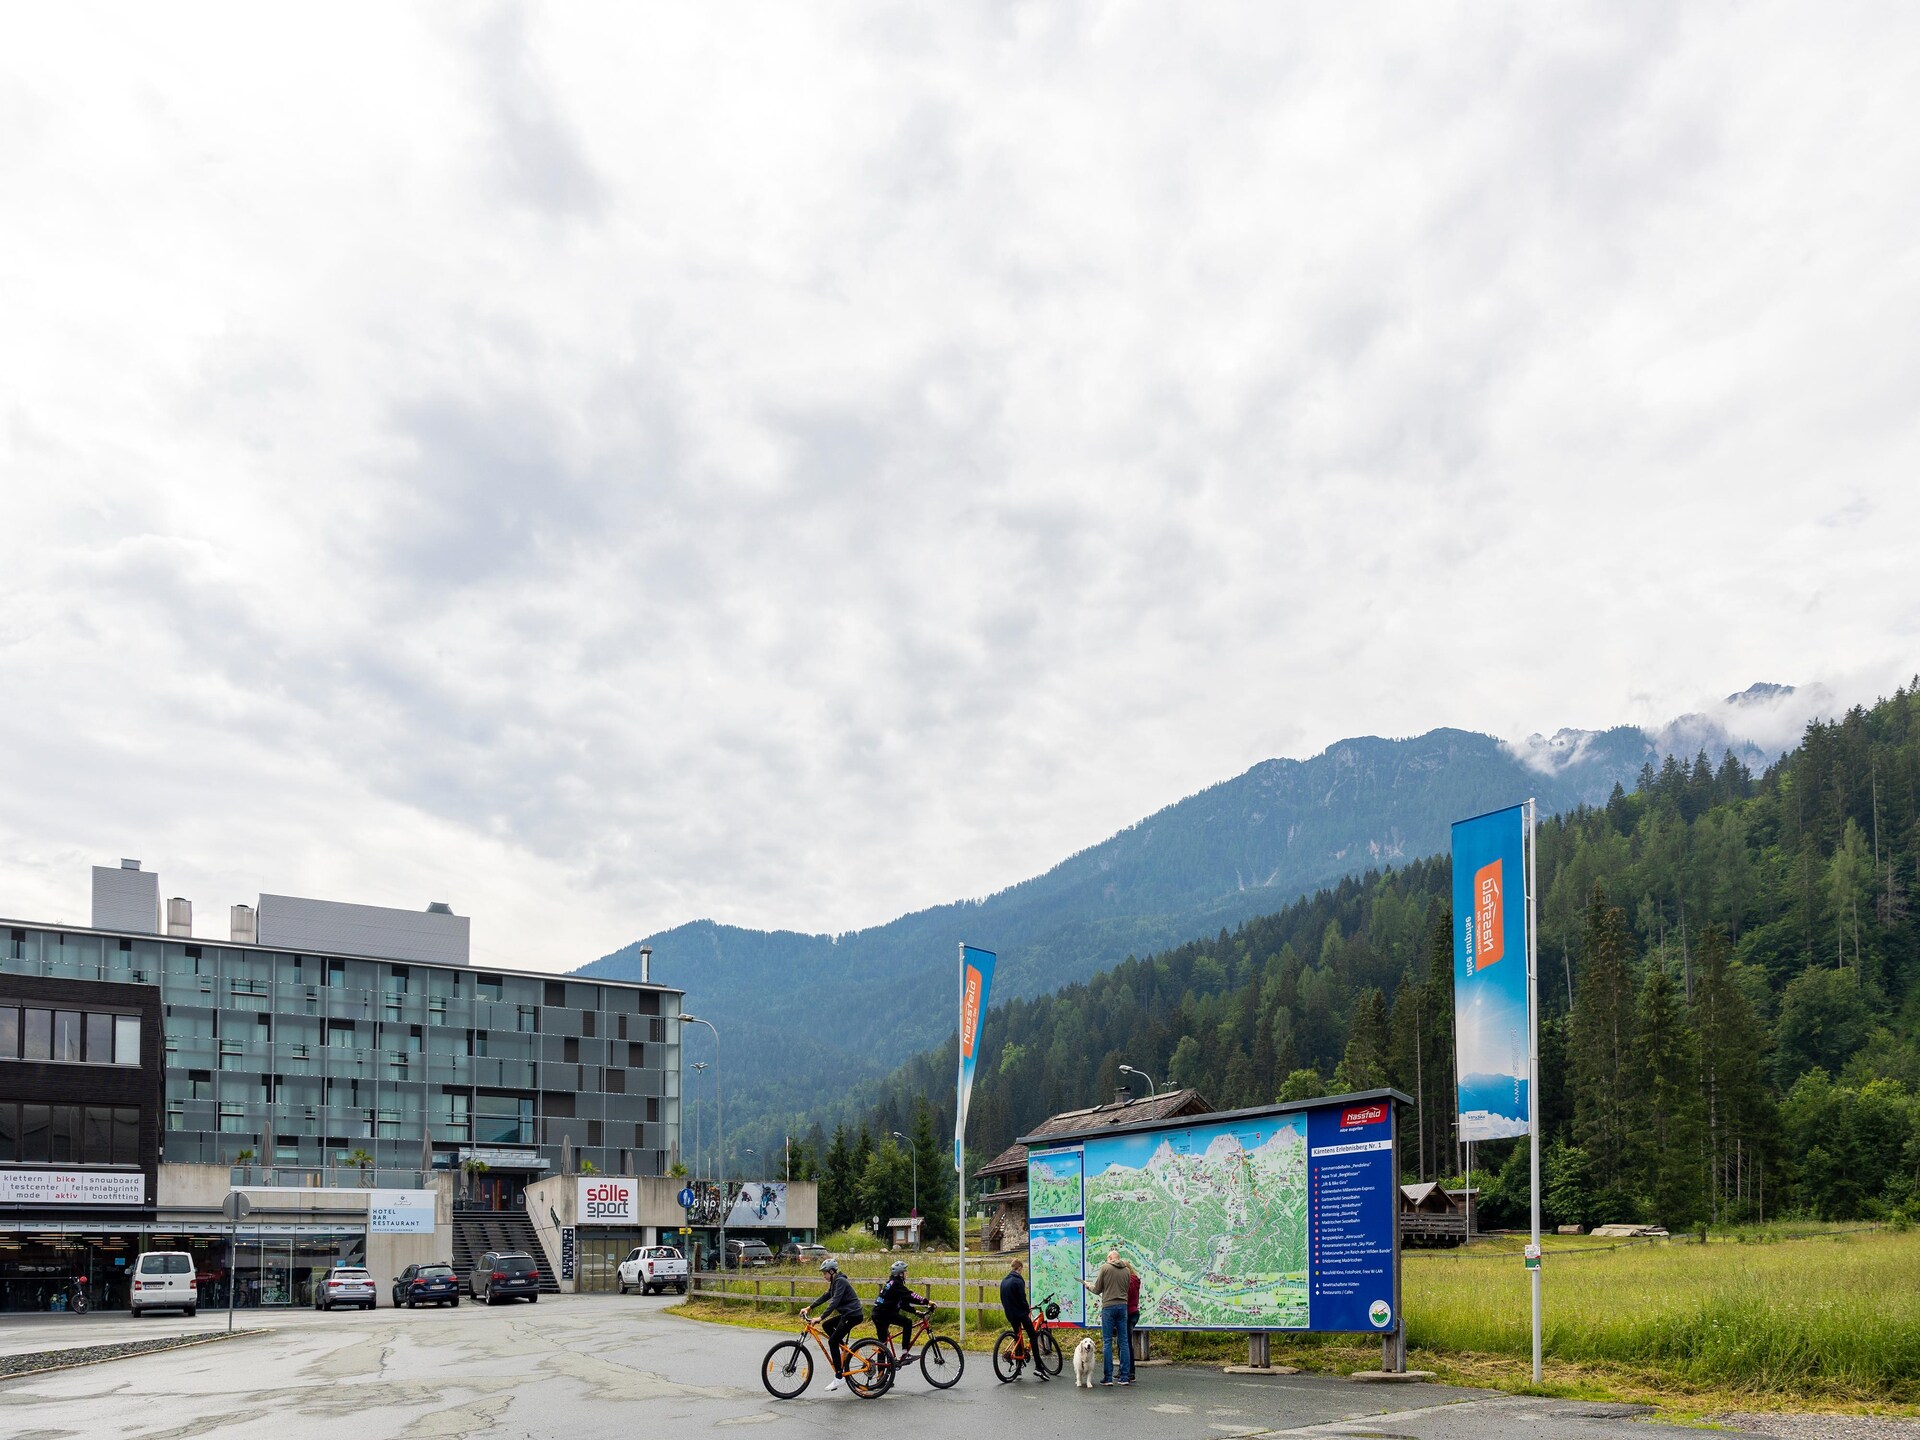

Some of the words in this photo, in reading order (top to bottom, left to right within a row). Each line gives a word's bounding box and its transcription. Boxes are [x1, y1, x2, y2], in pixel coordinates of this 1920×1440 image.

[964, 980, 976, 1044] Nassfeld
[1347, 1110, 1381, 1121] Nassfeld
[1336, 1144, 1368, 1152] Erlebnisberg
[72, 1185, 139, 1193] felsenlabyrinth
[587, 1184, 628, 1201] sölle
[93, 1193, 139, 1202] bootfitting
[587, 1199, 628, 1218] sport
